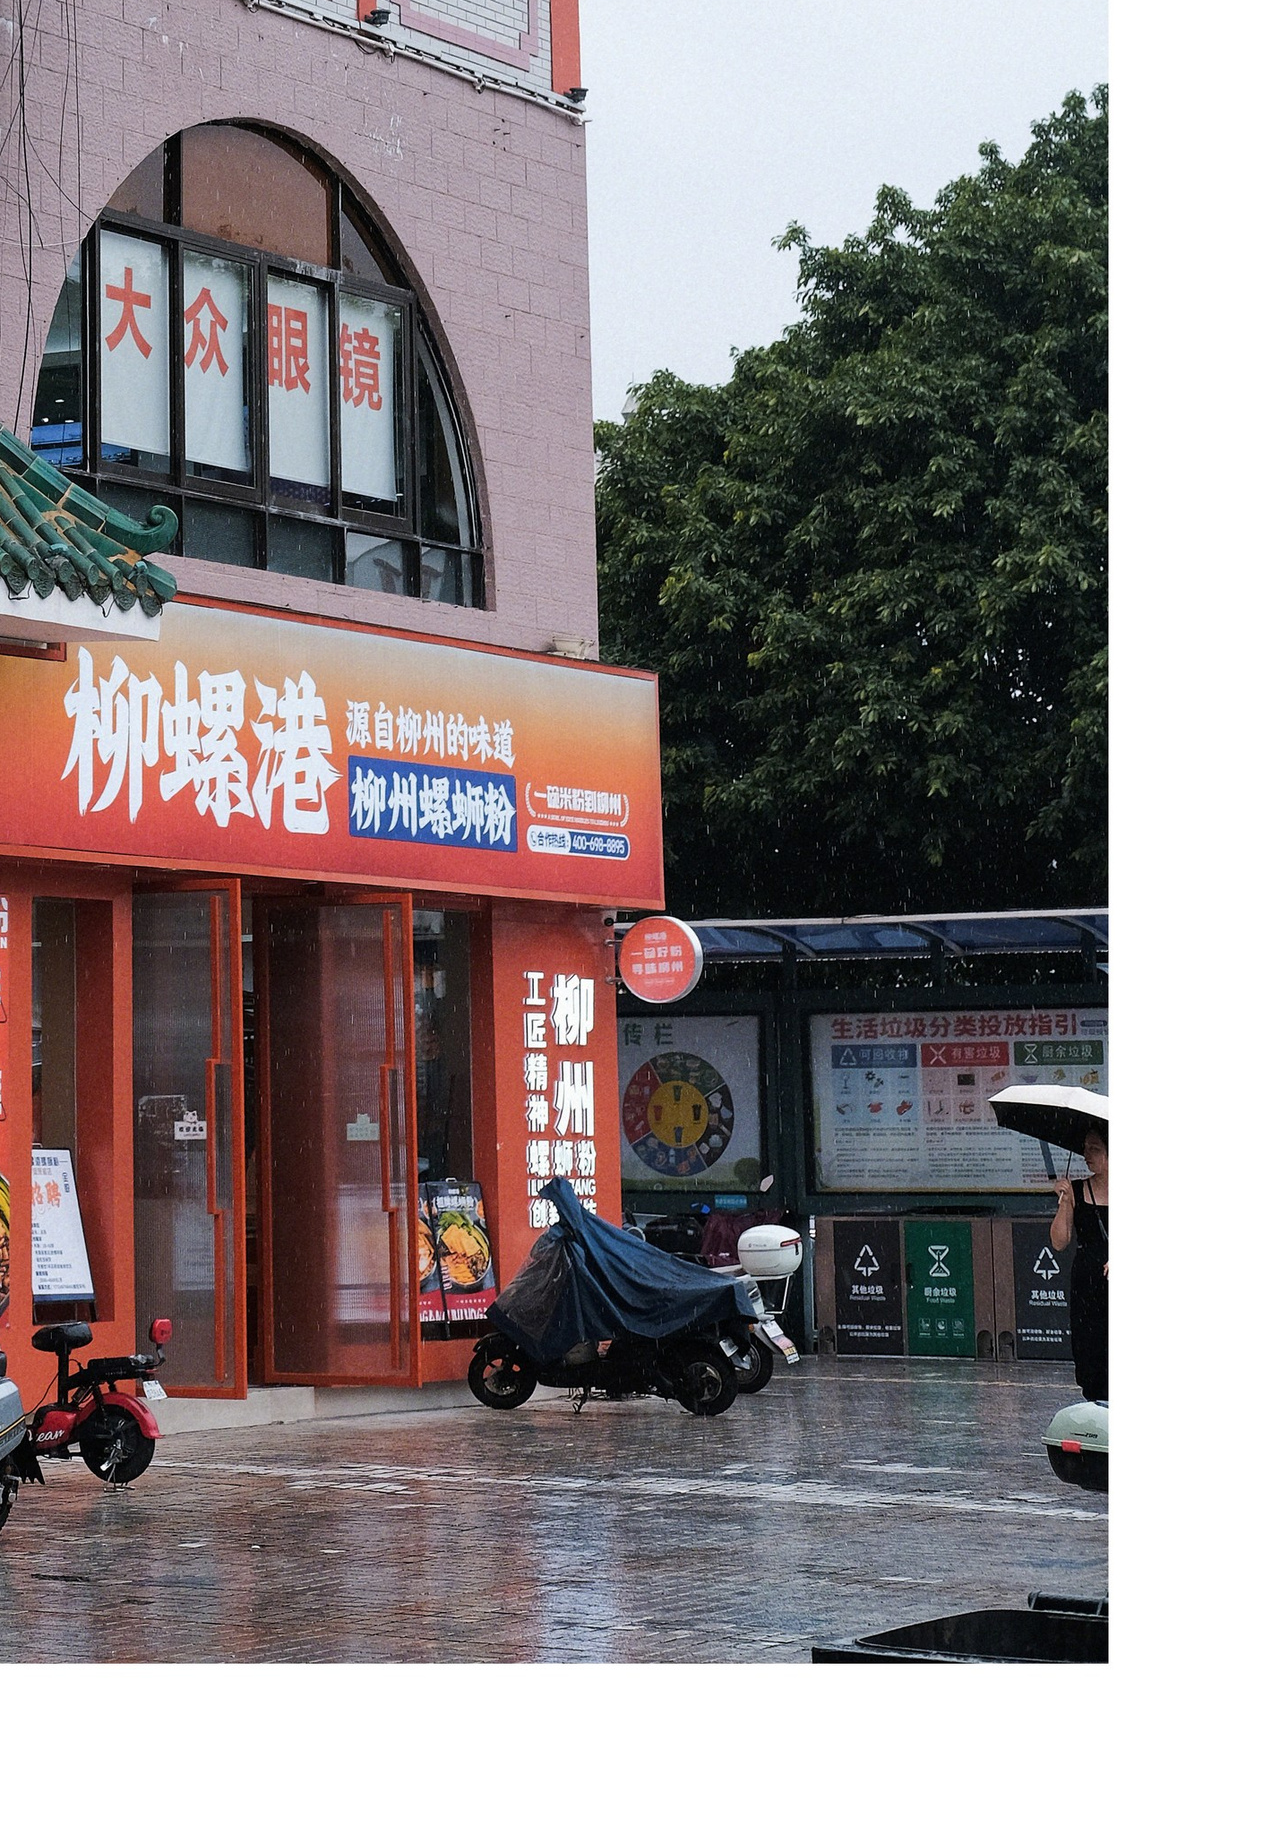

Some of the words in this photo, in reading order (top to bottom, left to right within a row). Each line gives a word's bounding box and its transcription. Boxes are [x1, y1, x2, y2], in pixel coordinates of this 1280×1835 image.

[104, 266, 384, 412] 大众眼镜
[61, 646, 343, 835] 柳螺港
[346, 699, 517, 769] 源自柳州的味道
[351, 766, 517, 846] 柳州螺蛳粉
[622, 1022, 674, 1047] 传栏
[831, 1014, 1078, 1040] 生活垃圾分类投放指引
[523, 970, 549, 1133] 工匠精神
[550, 973, 596, 1137] 柳州
[860, 1046, 909, 1062] 可回收物
[951, 1044, 1001, 1060] 有害垃圾
[1042, 1042, 1094, 1059] 厨余垃圾
[526, 1139, 597, 1179] 螺蛳粉
[852, 1285, 883, 1295] 其他垃圾
[924, 1287, 957, 1297] 厨余垃圾
[1031, 1290, 1065, 1300] 其他垃圾
